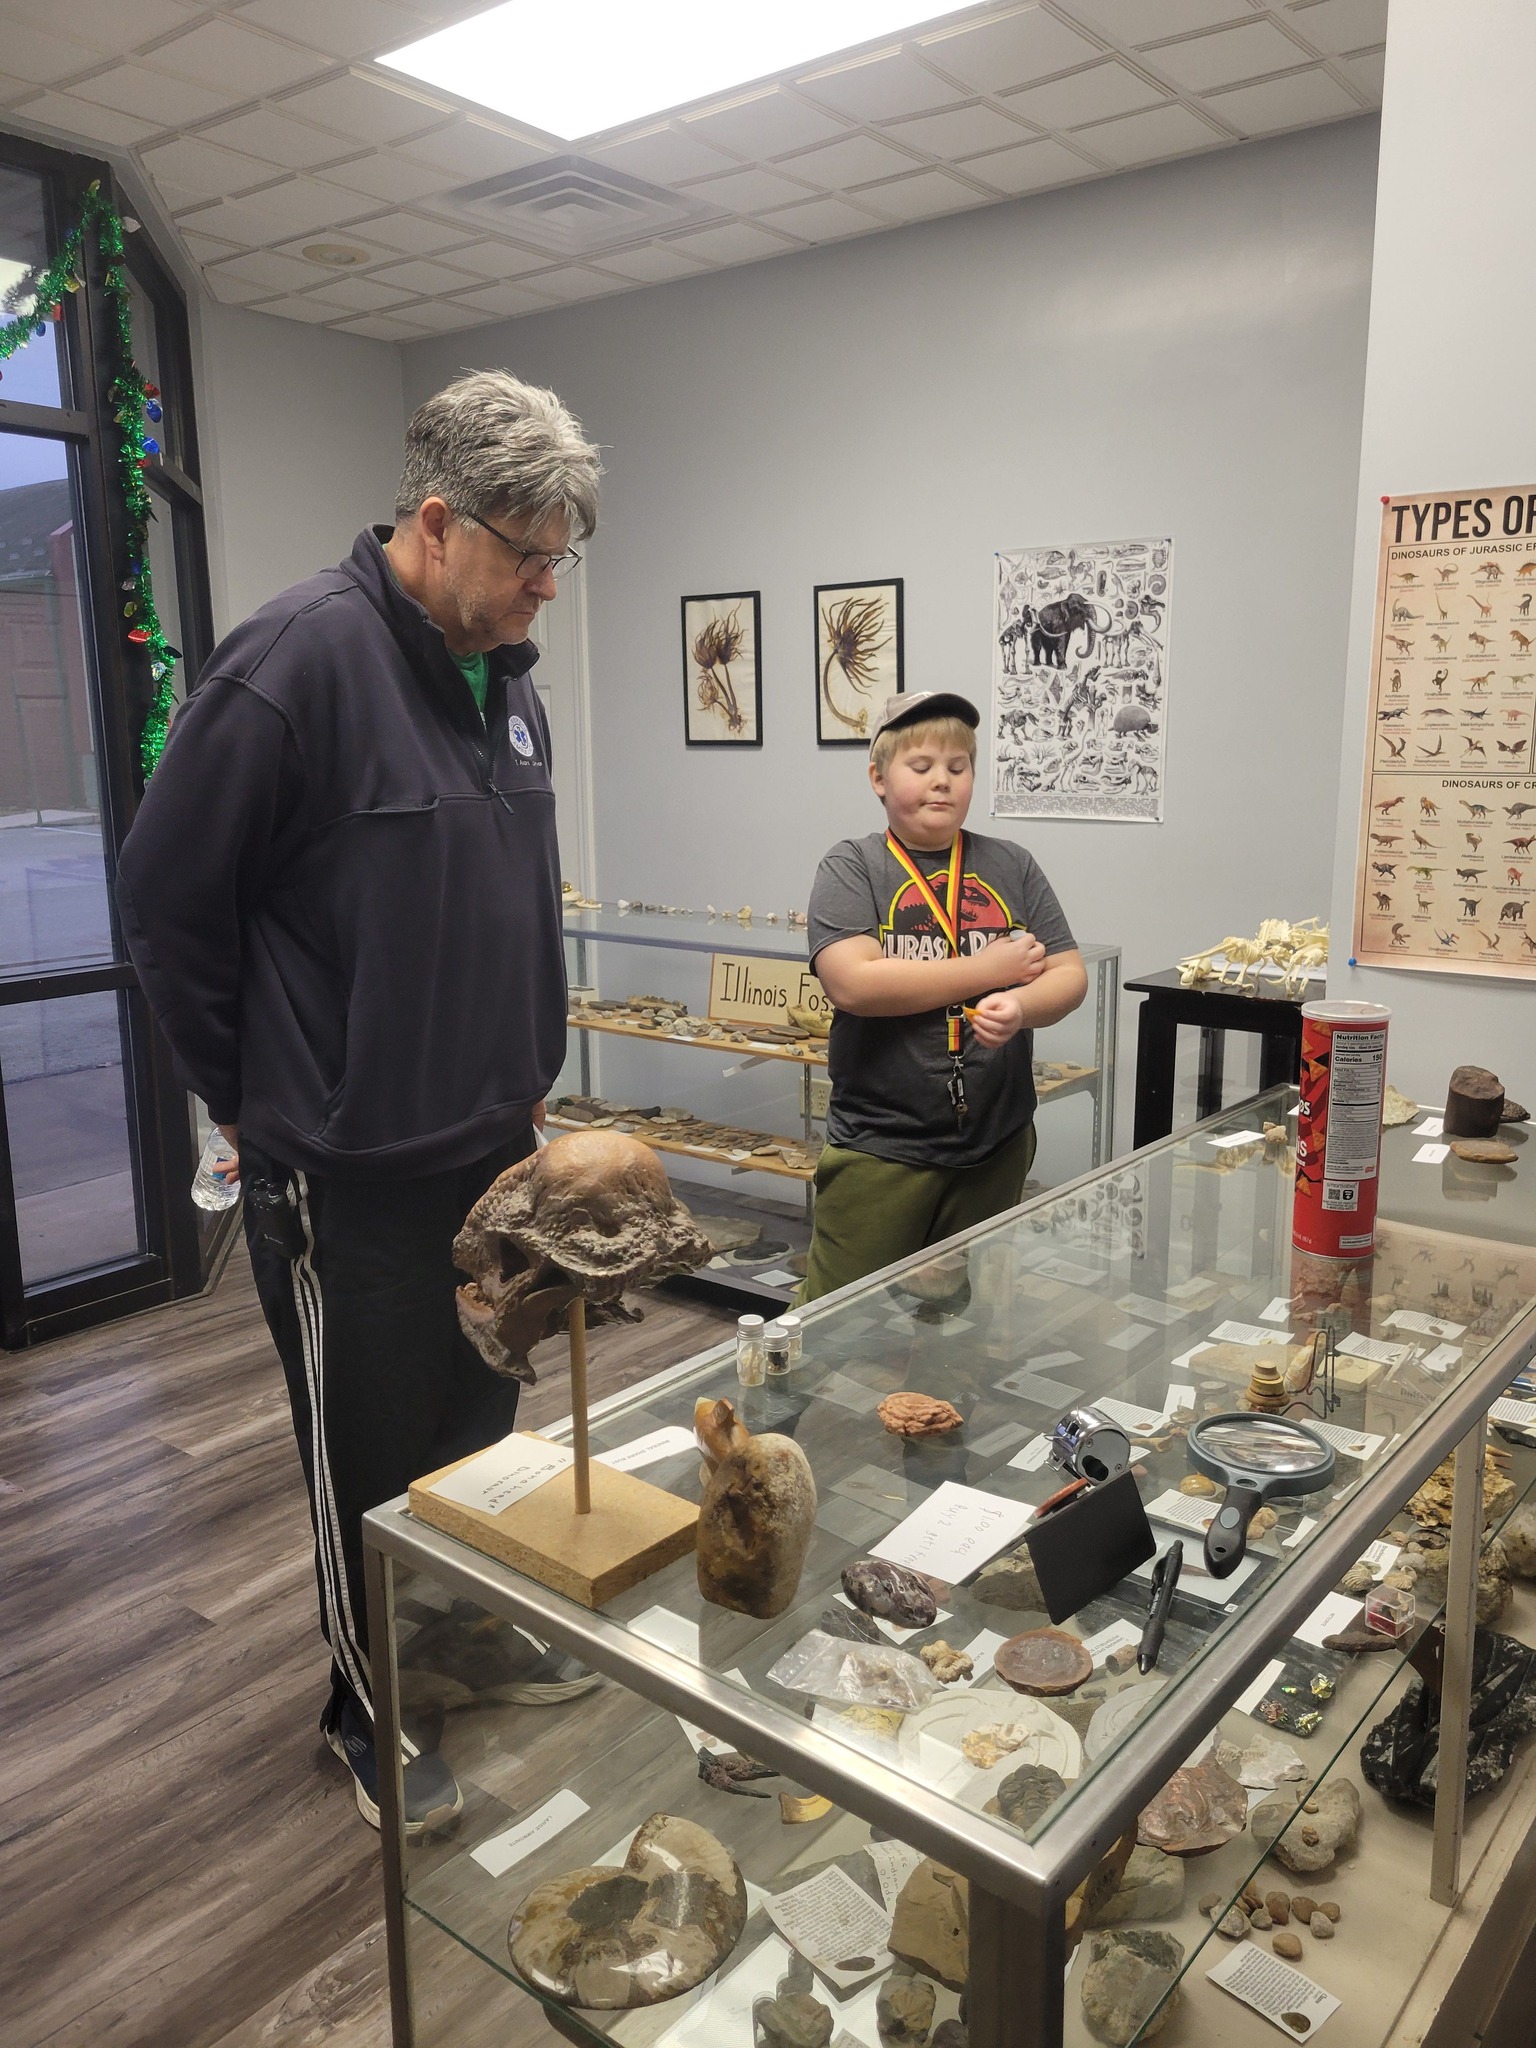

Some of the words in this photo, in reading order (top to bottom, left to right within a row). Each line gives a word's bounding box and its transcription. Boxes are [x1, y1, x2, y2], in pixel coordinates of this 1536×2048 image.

[1391, 497, 1493, 543] TYPES
[1391, 548, 1450, 560] DINOSAURS
[1452, 546, 1467, 556] OF
[1469, 543, 1523, 555] JURASSIC
[1441, 779, 1503, 789] DINOSAURS
[1506, 781, 1521, 789] OF
[720, 962, 787, 1008] Illinois
